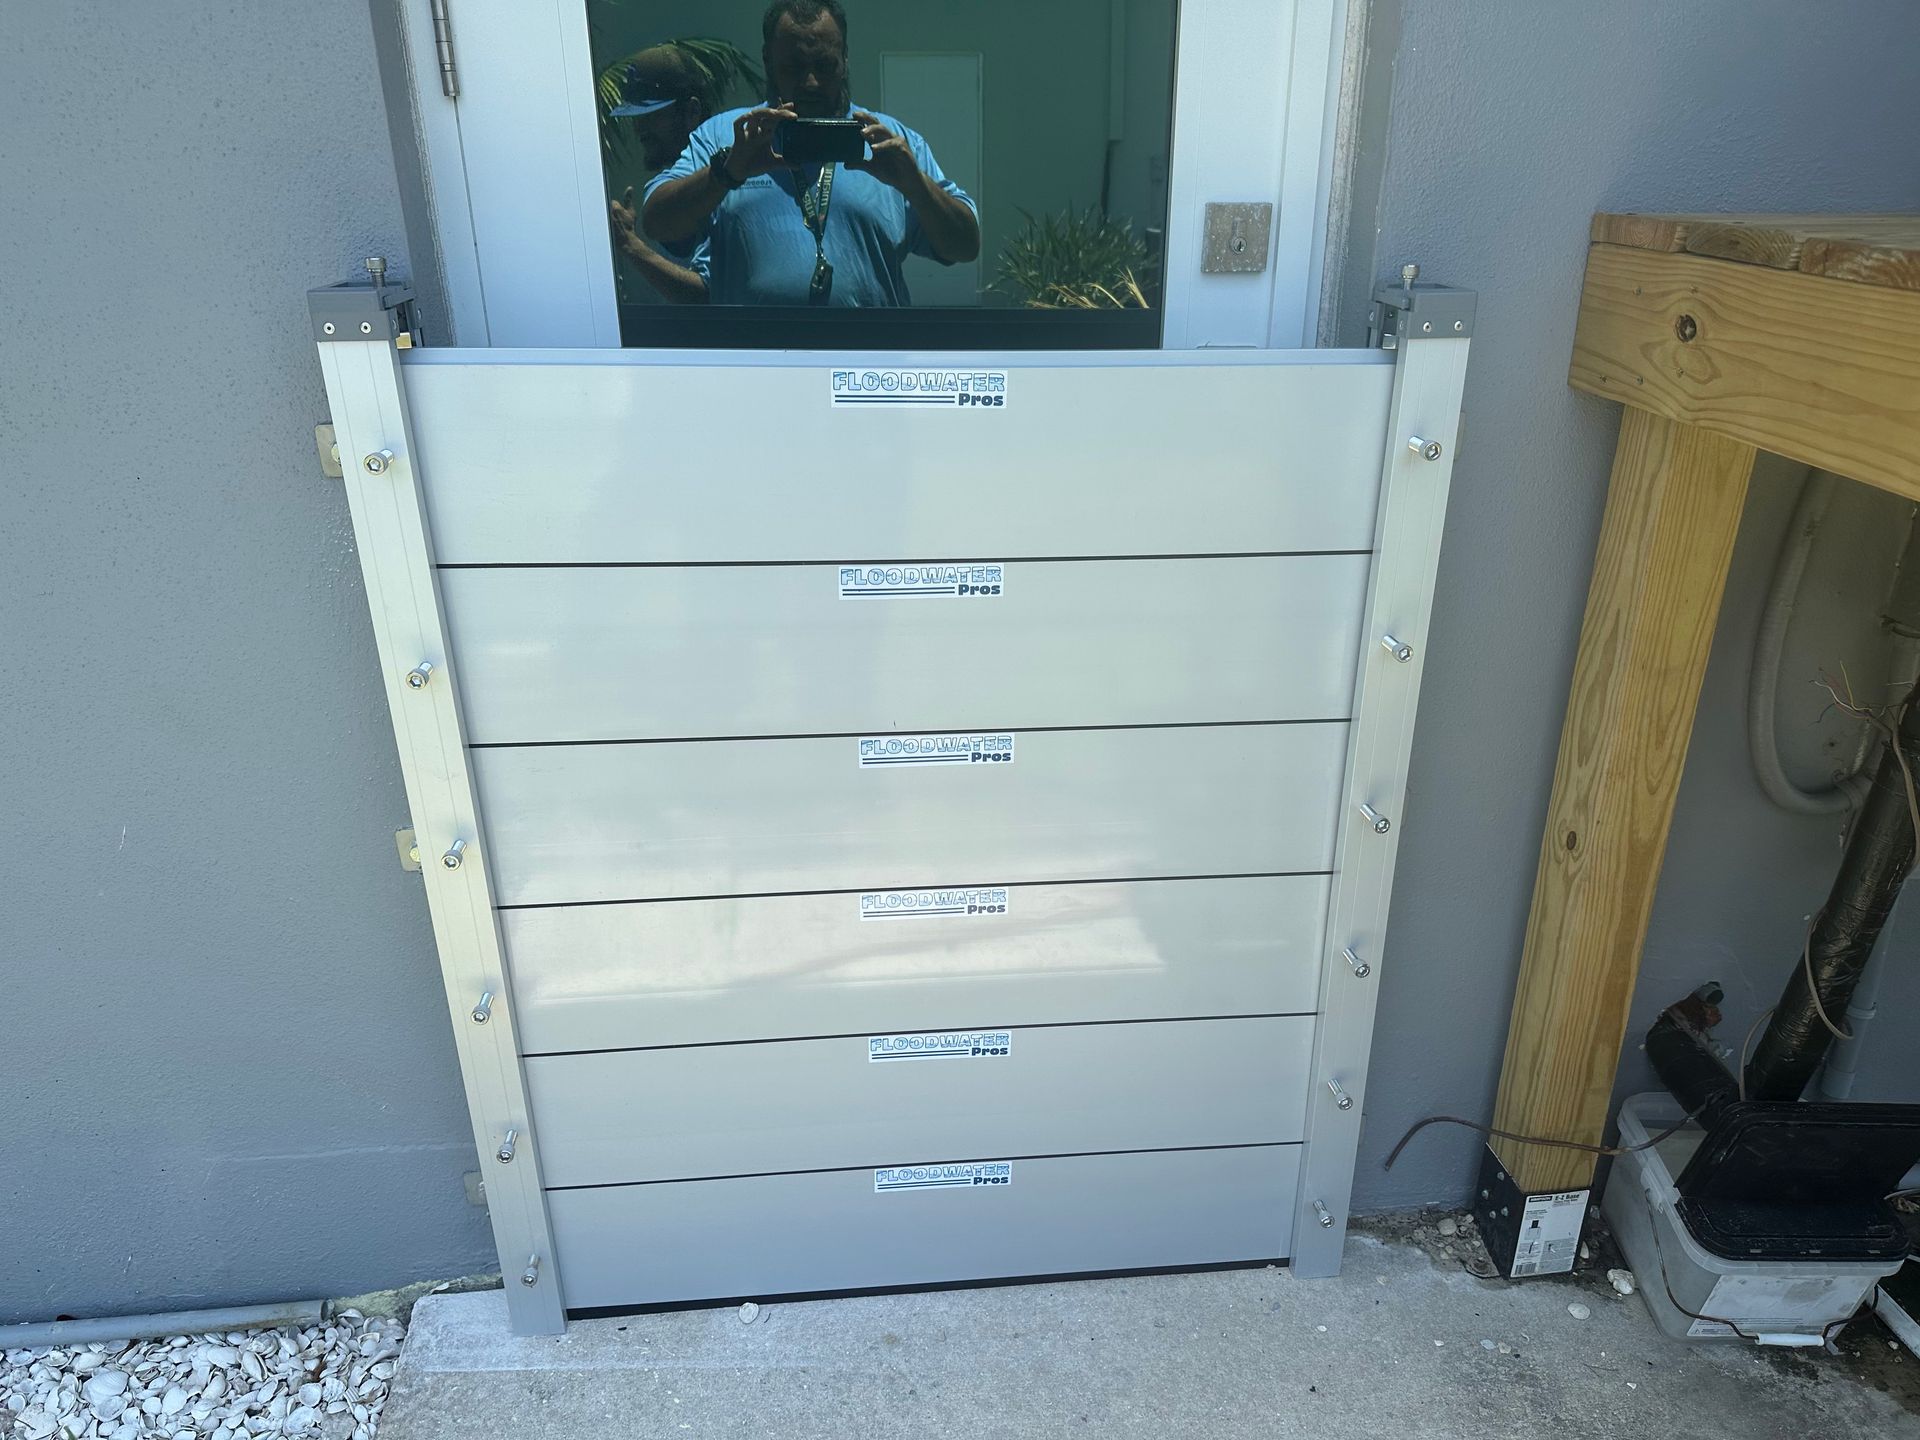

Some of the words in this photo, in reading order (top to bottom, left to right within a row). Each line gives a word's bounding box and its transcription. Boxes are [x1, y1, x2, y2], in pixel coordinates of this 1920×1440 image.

[832, 371, 1005, 392] FLOODWATER
[958, 393, 1005, 407] Pros
[840, 566, 1002, 586] FLOODWATER
[958, 584, 1001, 596] Pros
[860, 735, 1013, 755] FLOODWATER
[971, 752, 1012, 763] Pros
[862, 888, 1007, 909] FLOODWATER
[967, 904, 1006, 915] Pros
[870, 1032, 1010, 1052] FLOODWATER
[971, 1046, 1009, 1056] Pros
[876, 1163, 1010, 1183] FLOODWATER
[973, 1176, 1009, 1185] Pros
